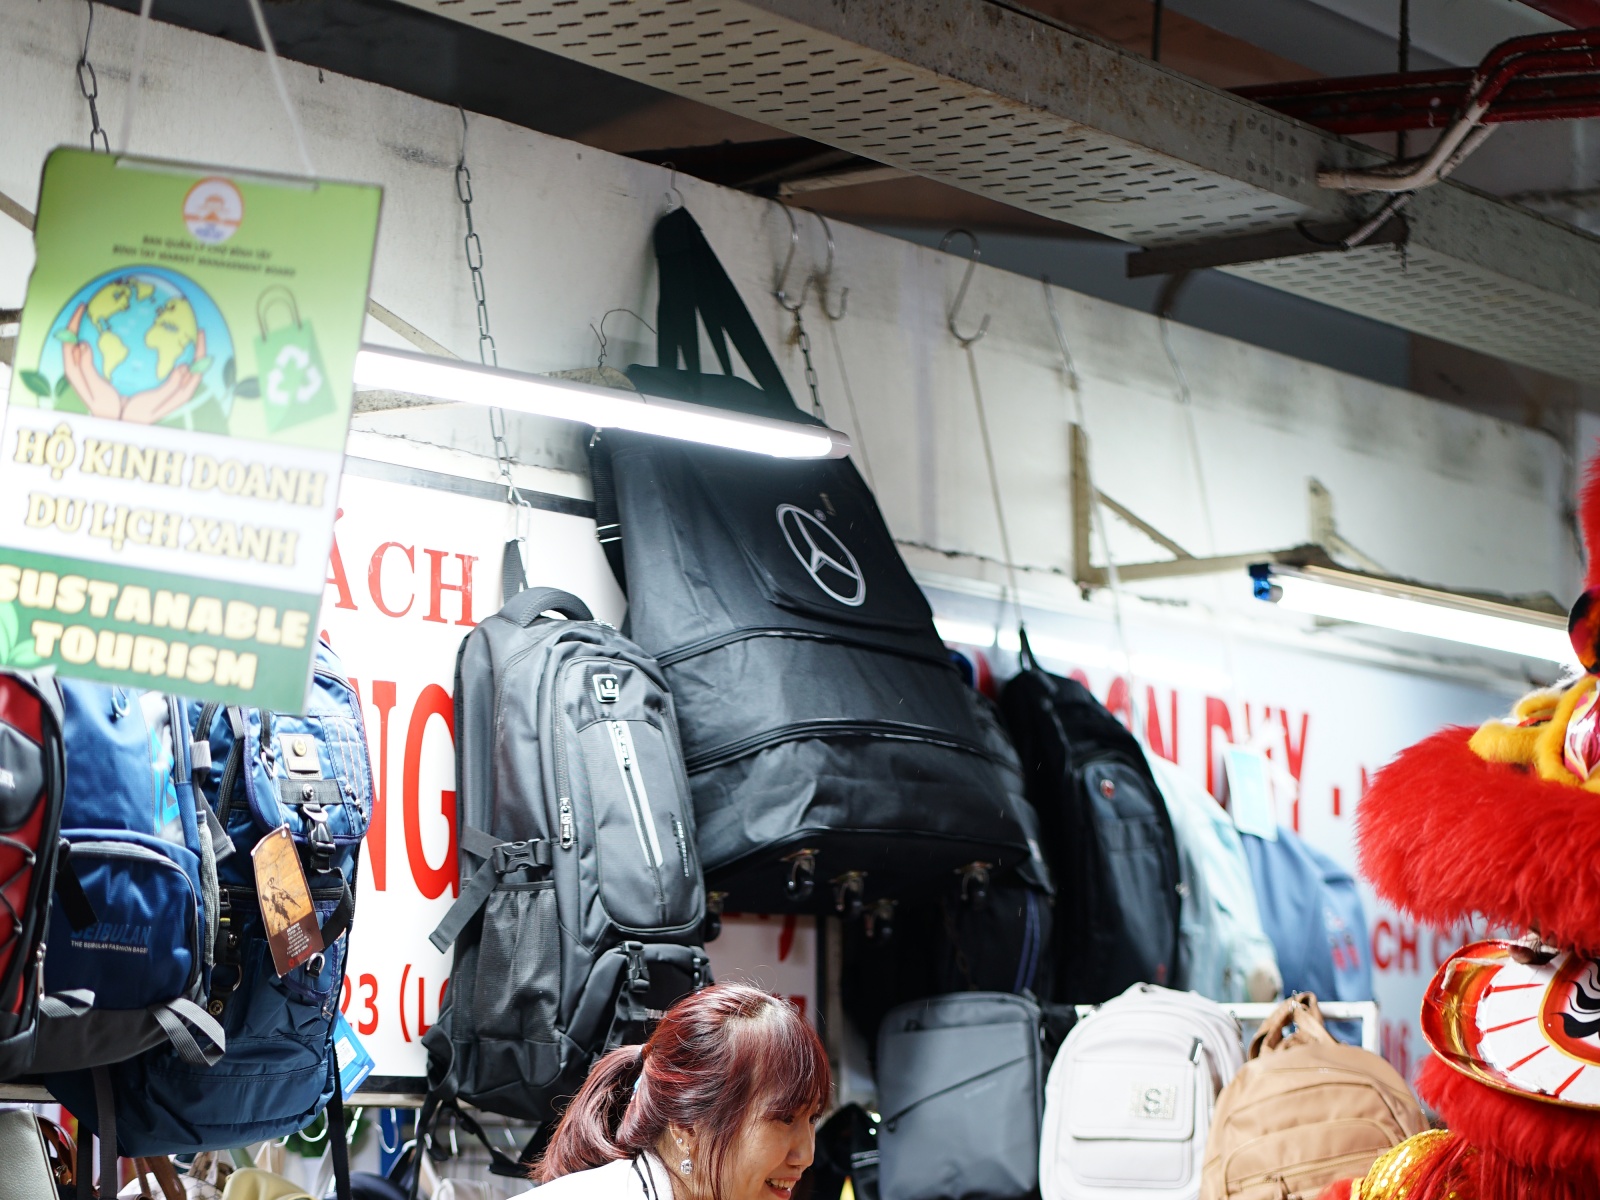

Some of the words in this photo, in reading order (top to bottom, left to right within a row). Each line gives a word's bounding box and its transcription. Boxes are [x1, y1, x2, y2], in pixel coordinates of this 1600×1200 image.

[13, 423, 77, 480] HỘ
[80, 437, 186, 488] KINH
[190, 454, 328, 508] DOANH
[24, 492, 87, 533] DU
[89, 501, 183, 551] LỊCH
[185, 514, 299, 567] XANH
[0, 564, 311, 650] SUSTANABLE
[31, 619, 259, 692] TOURISM
[71, 940, 83, 948] THE
[108, 943, 132, 952] FASHION
